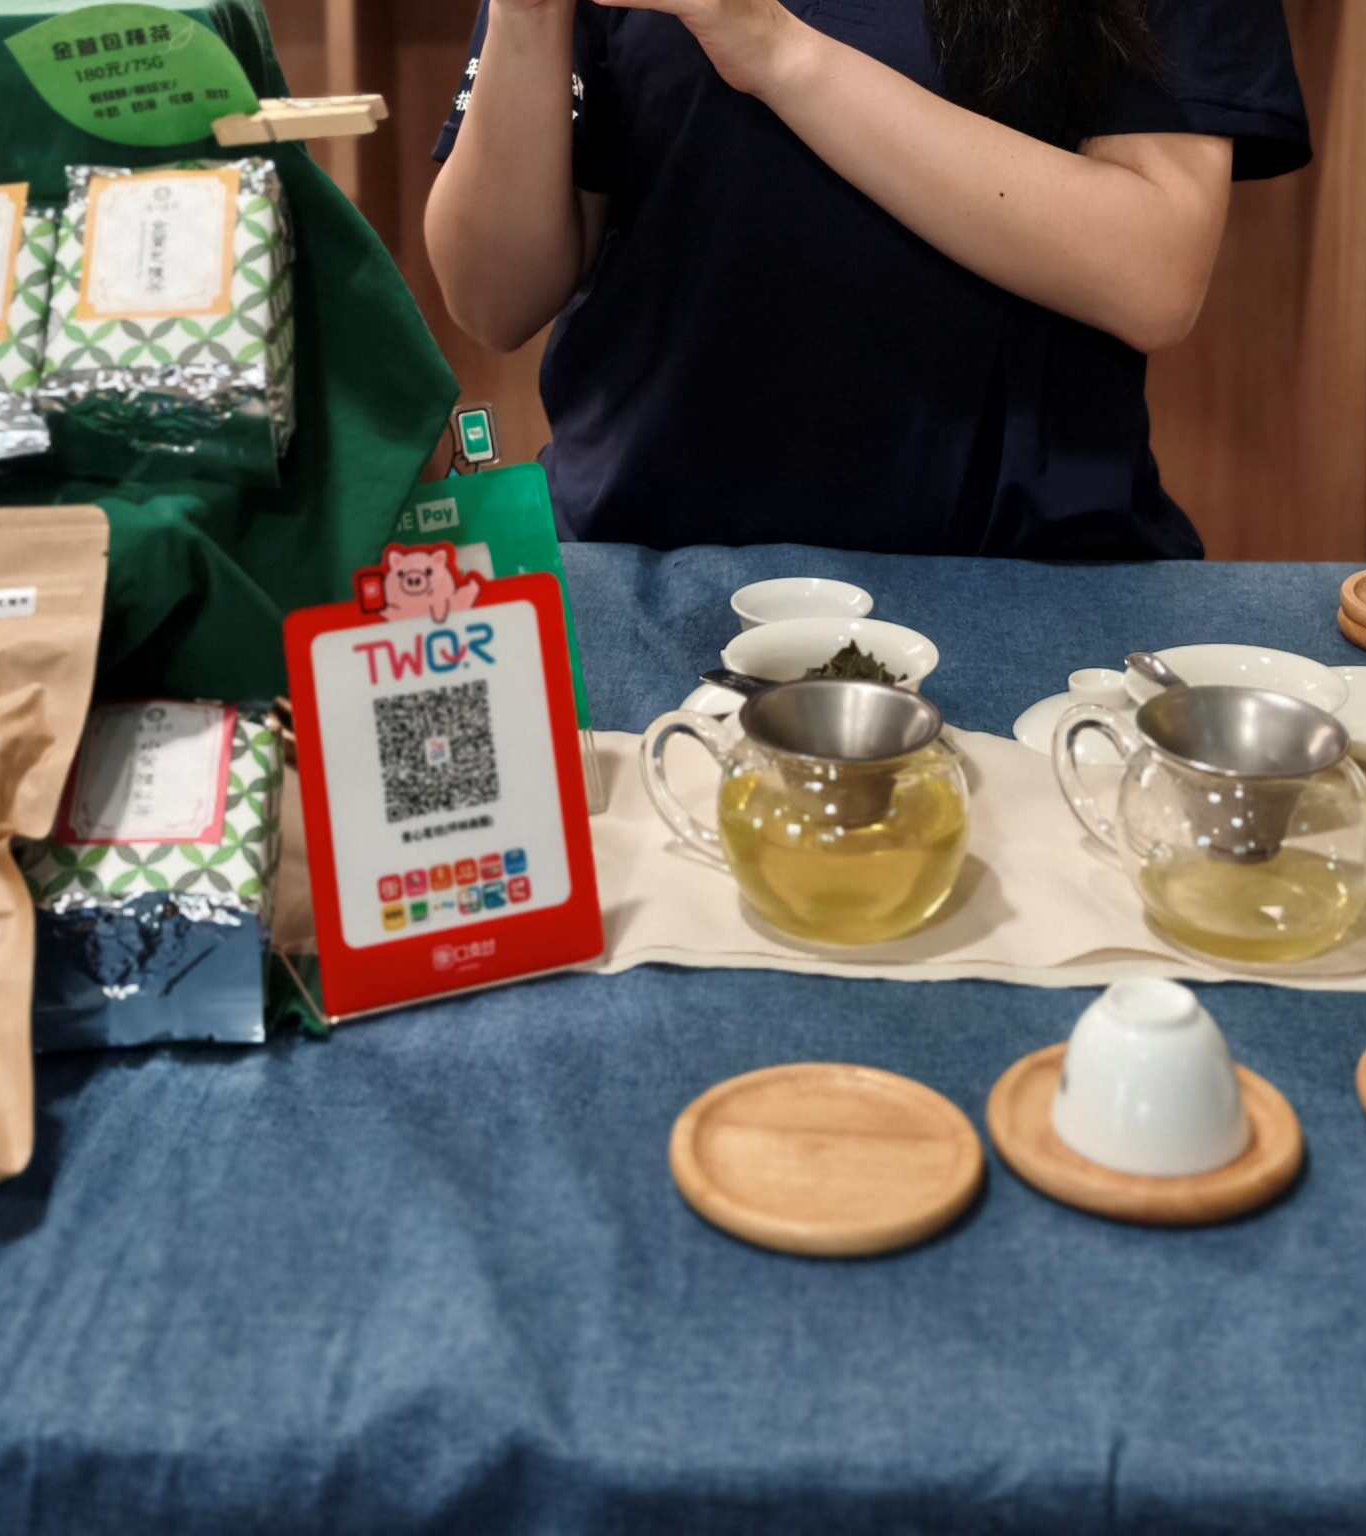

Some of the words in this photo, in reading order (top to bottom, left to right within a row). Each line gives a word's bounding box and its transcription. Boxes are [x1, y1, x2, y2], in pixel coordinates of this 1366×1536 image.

[75, 55, 165, 84] 180元/75G
[423, 507, 454, 526] Pay
[352, 622, 497, 686] TWQR
